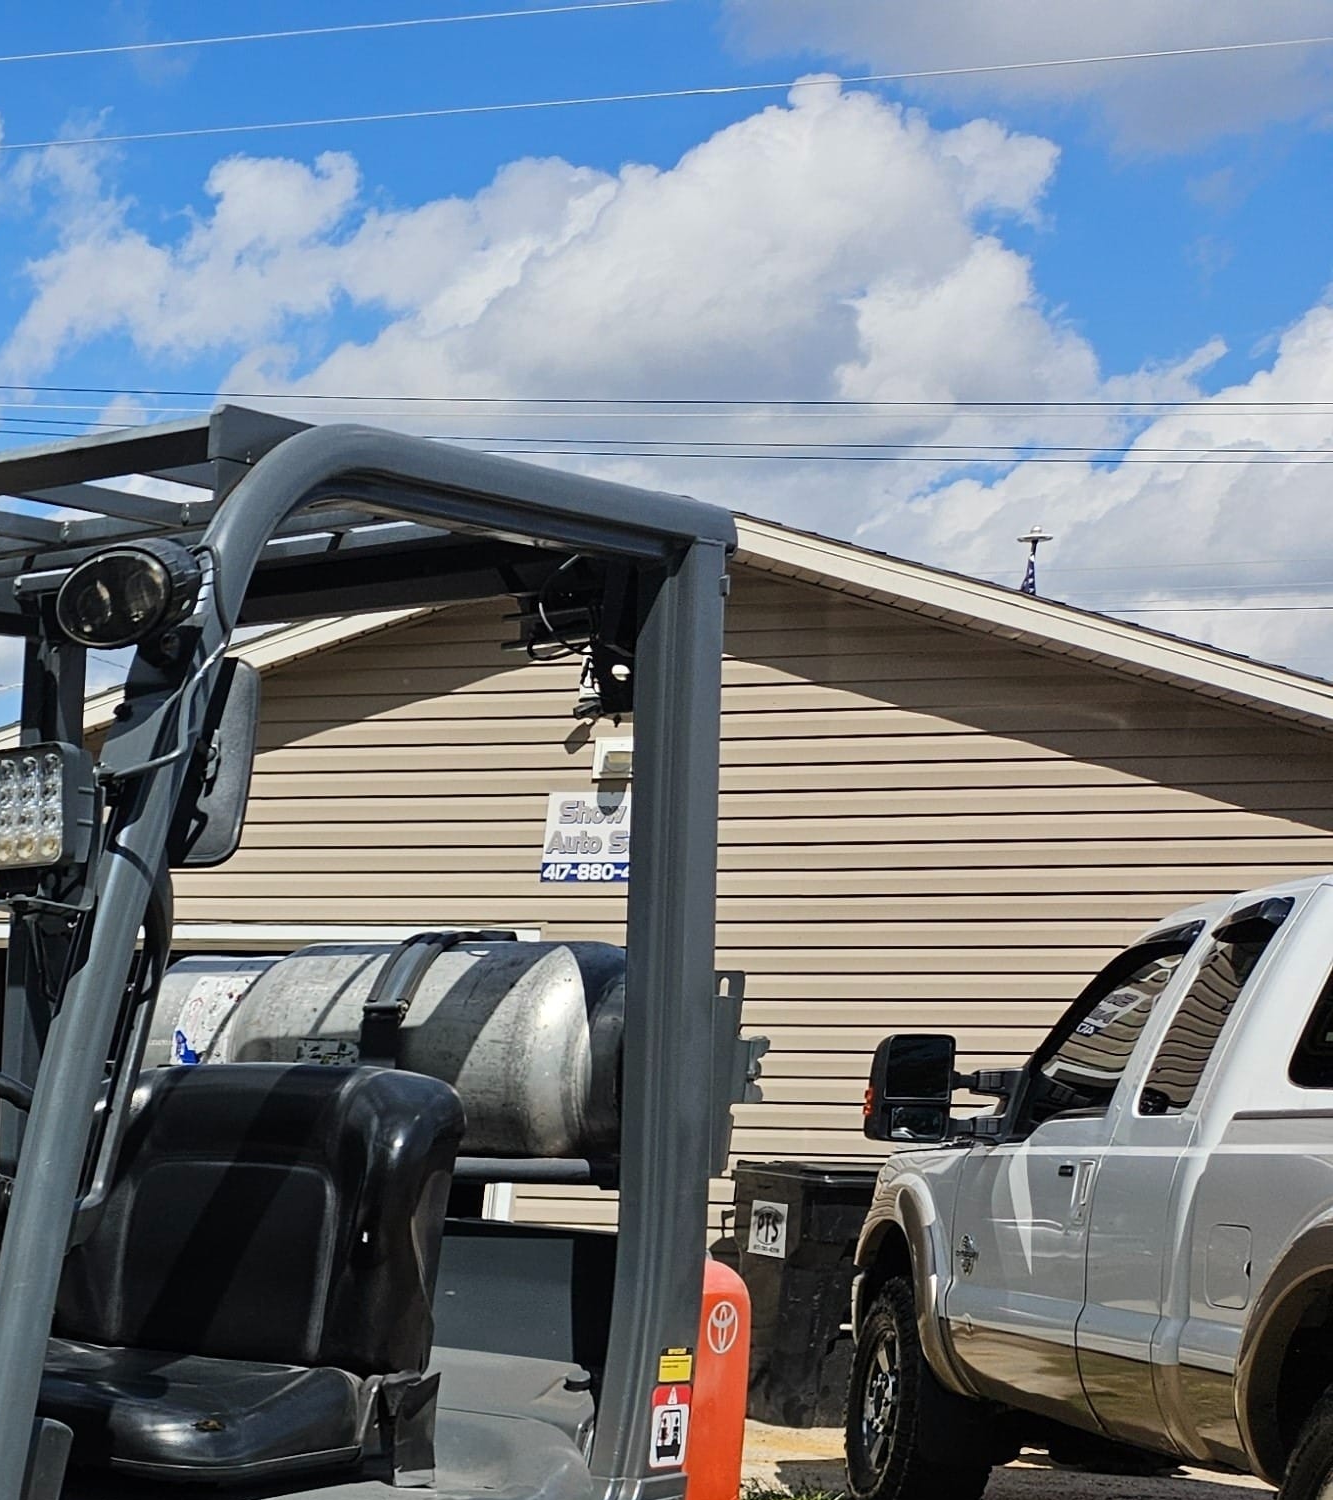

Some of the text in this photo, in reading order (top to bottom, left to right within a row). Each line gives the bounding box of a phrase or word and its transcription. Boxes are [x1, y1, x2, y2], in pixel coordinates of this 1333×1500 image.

[559, 800, 627, 824] Show
[545, 830, 603, 854] Auto
[542, 863, 630, 881] 417-880-4
